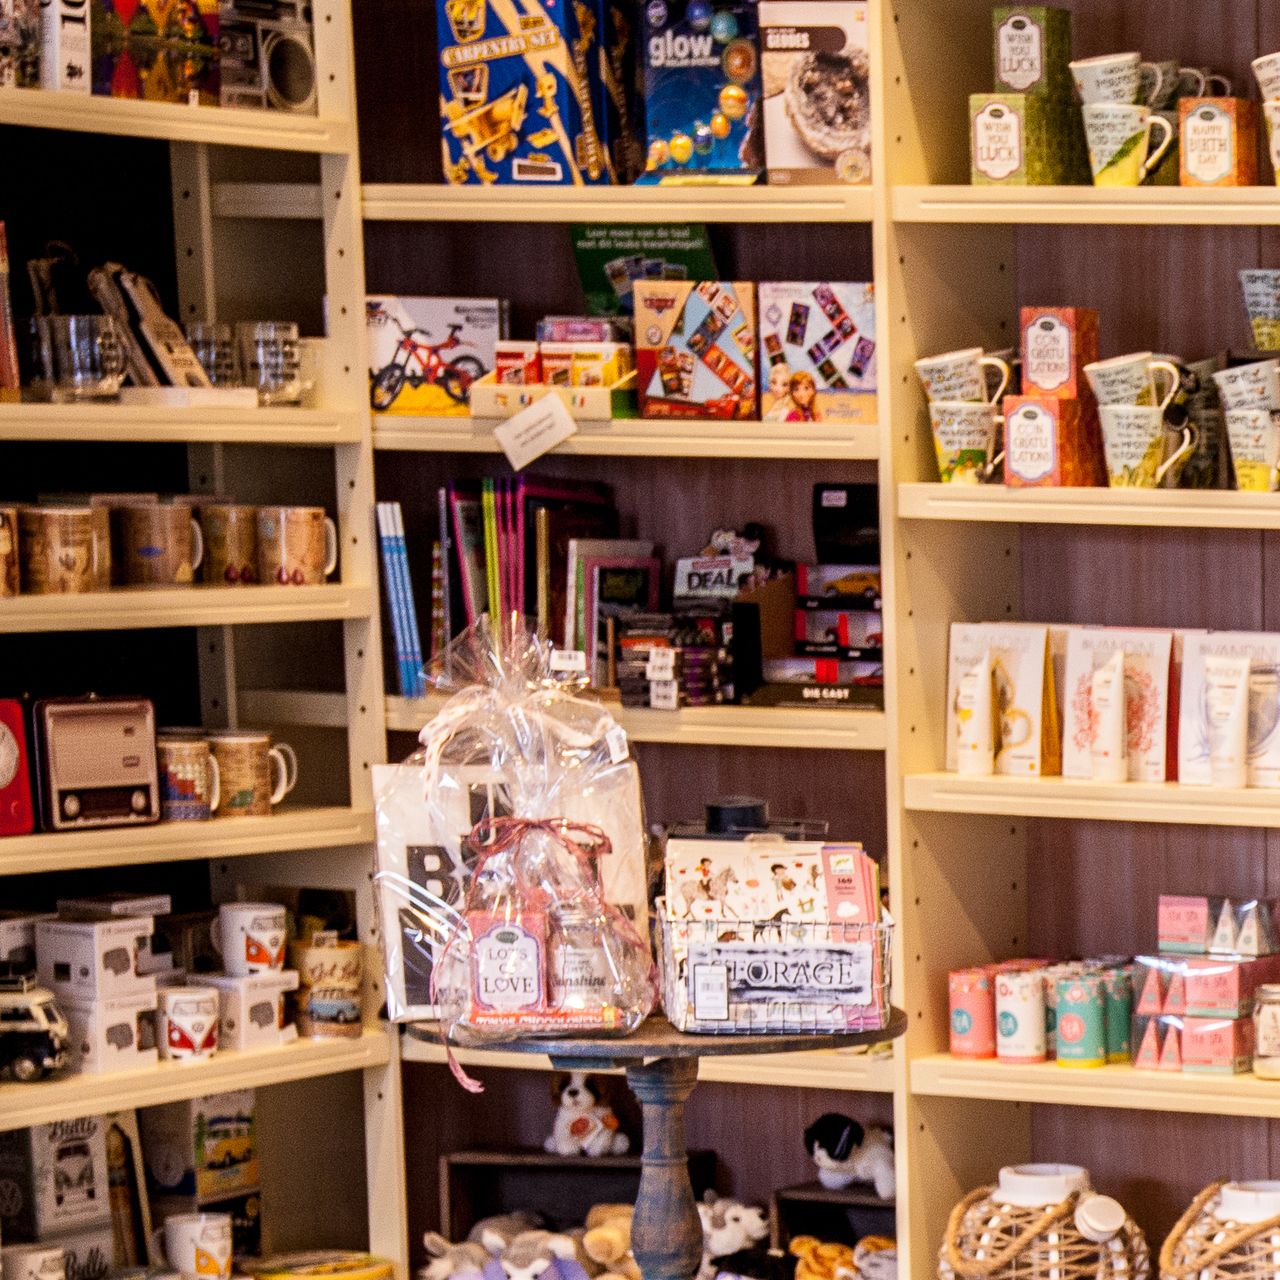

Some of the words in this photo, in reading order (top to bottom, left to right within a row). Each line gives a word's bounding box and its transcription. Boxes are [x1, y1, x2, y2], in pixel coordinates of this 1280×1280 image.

[442, 36, 526, 67] CARPENTRY
[648, 33, 714, 68] glow
[1003, 58, 1037, 73] LUCK
[979, 146, 1016, 162] LUCK
[687, 570, 738, 591] DEAL
[488, 947, 529, 961] LOTS
[712, 959, 854, 986] TORAGE
[484, 976, 535, 995] LOVE
